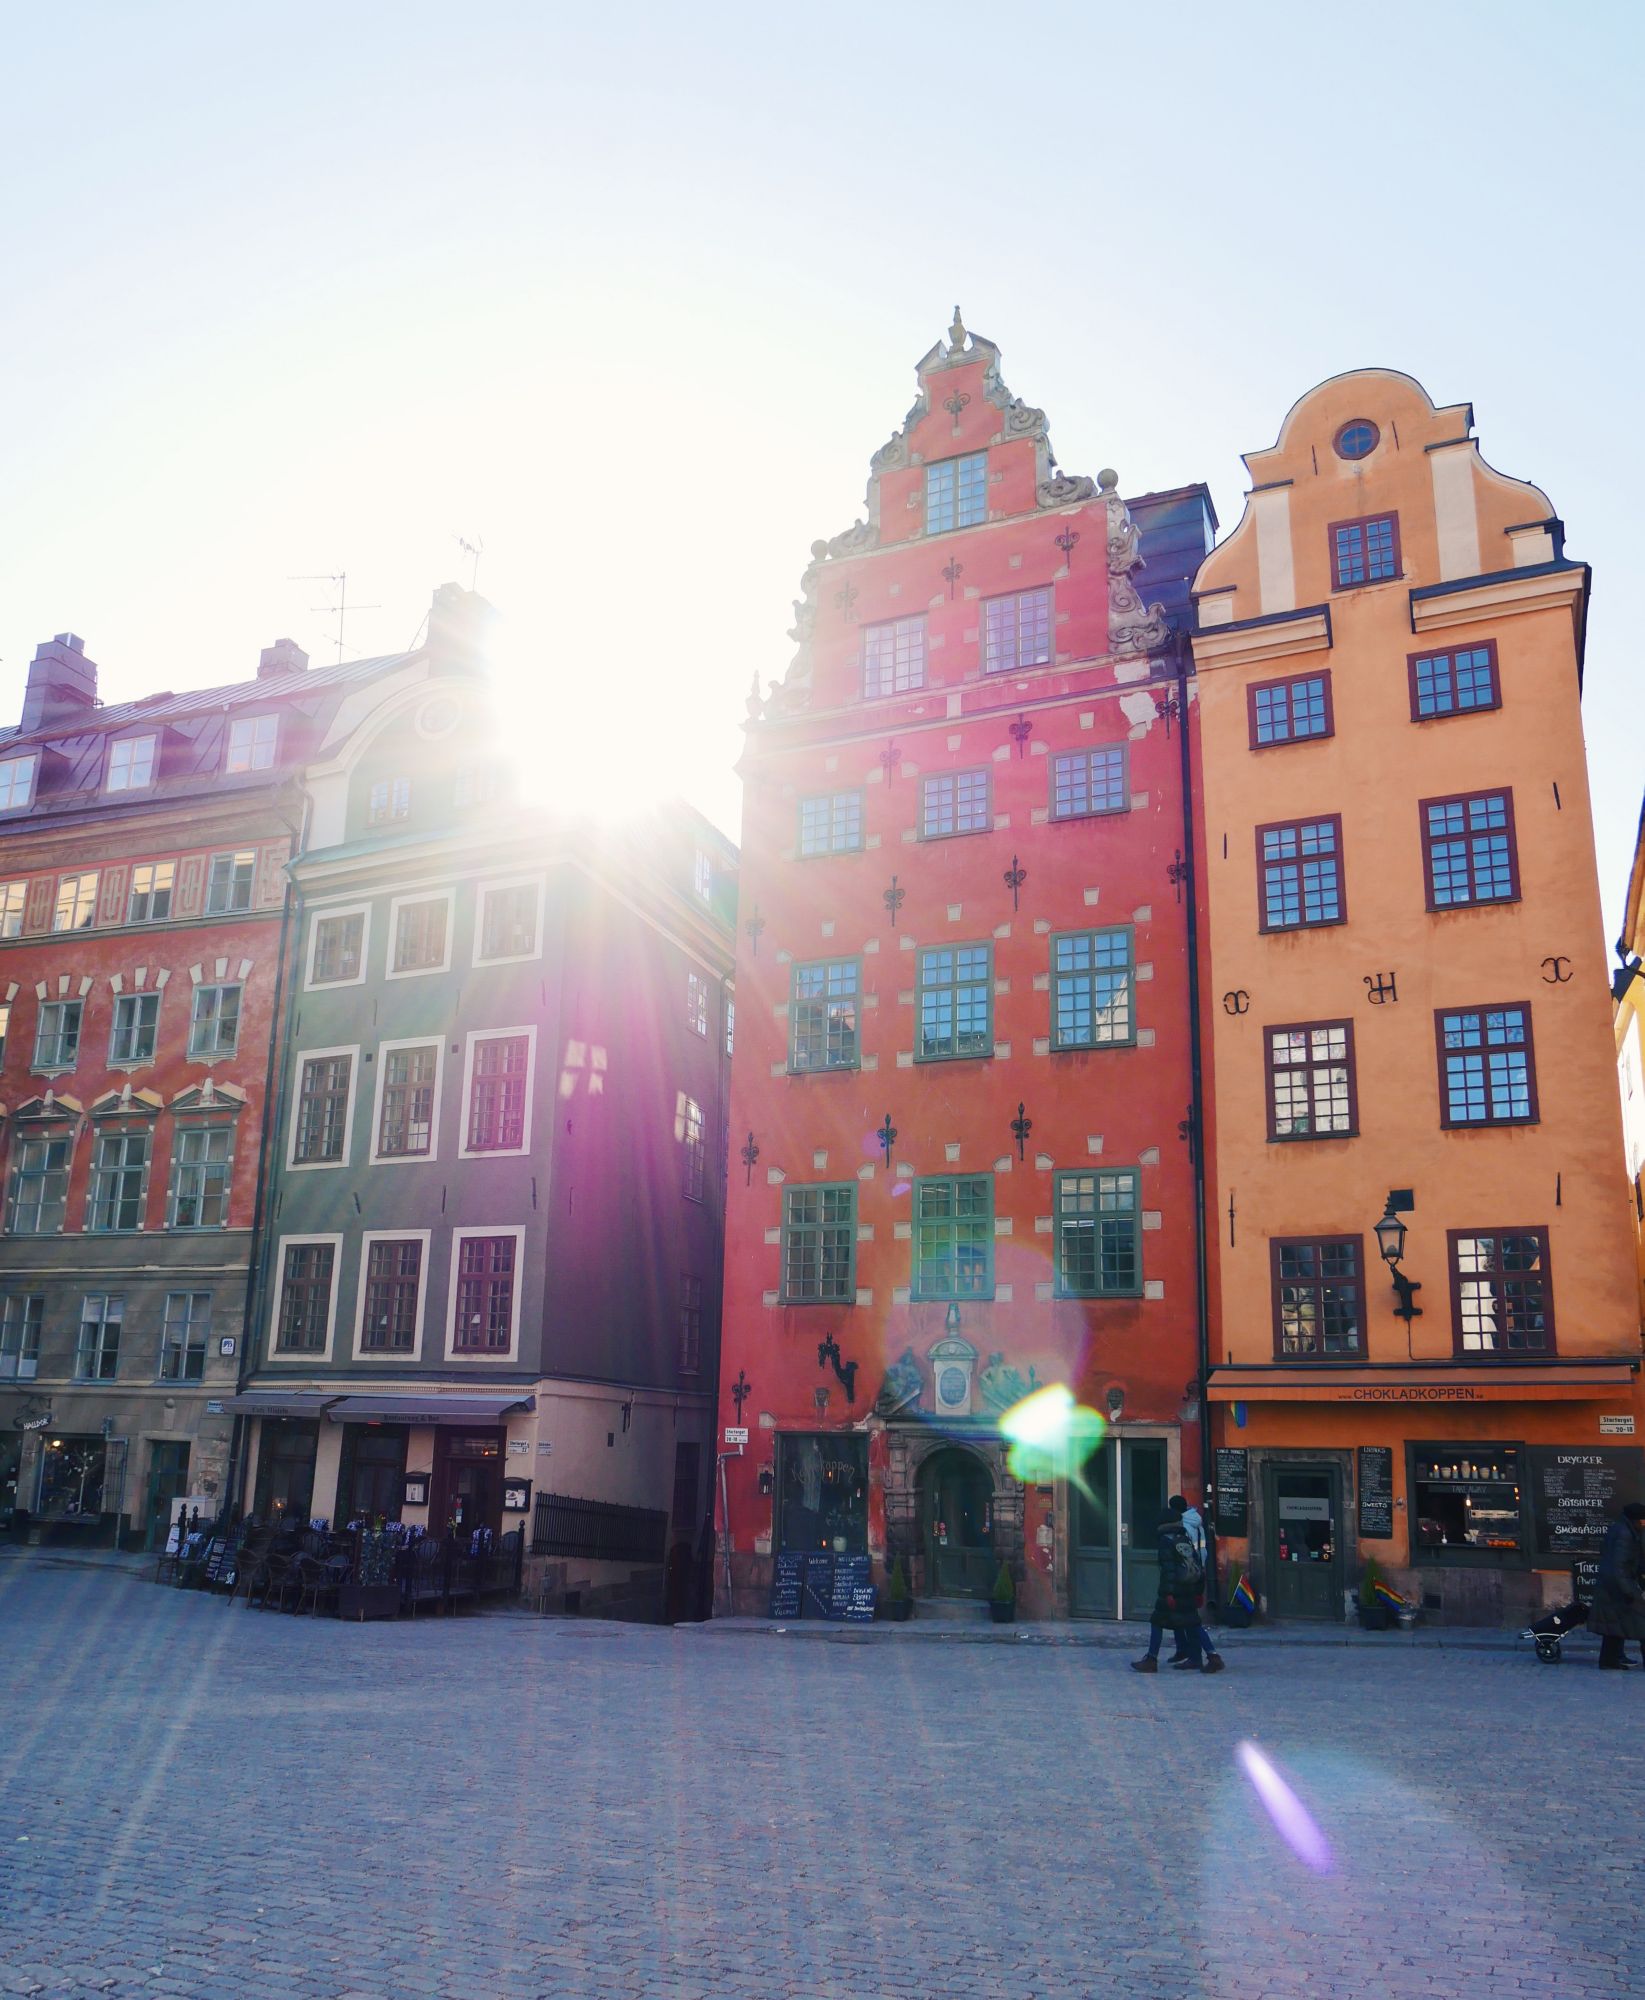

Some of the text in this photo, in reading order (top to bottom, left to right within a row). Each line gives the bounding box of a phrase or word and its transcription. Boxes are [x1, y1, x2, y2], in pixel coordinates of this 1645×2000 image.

[1557, 1455, 1603, 1465] DRYCKER
[1557, 1497, 1604, 1508] SÖTSAKER
[1554, 1523, 1608, 1535] SMÖRGÅSAR
